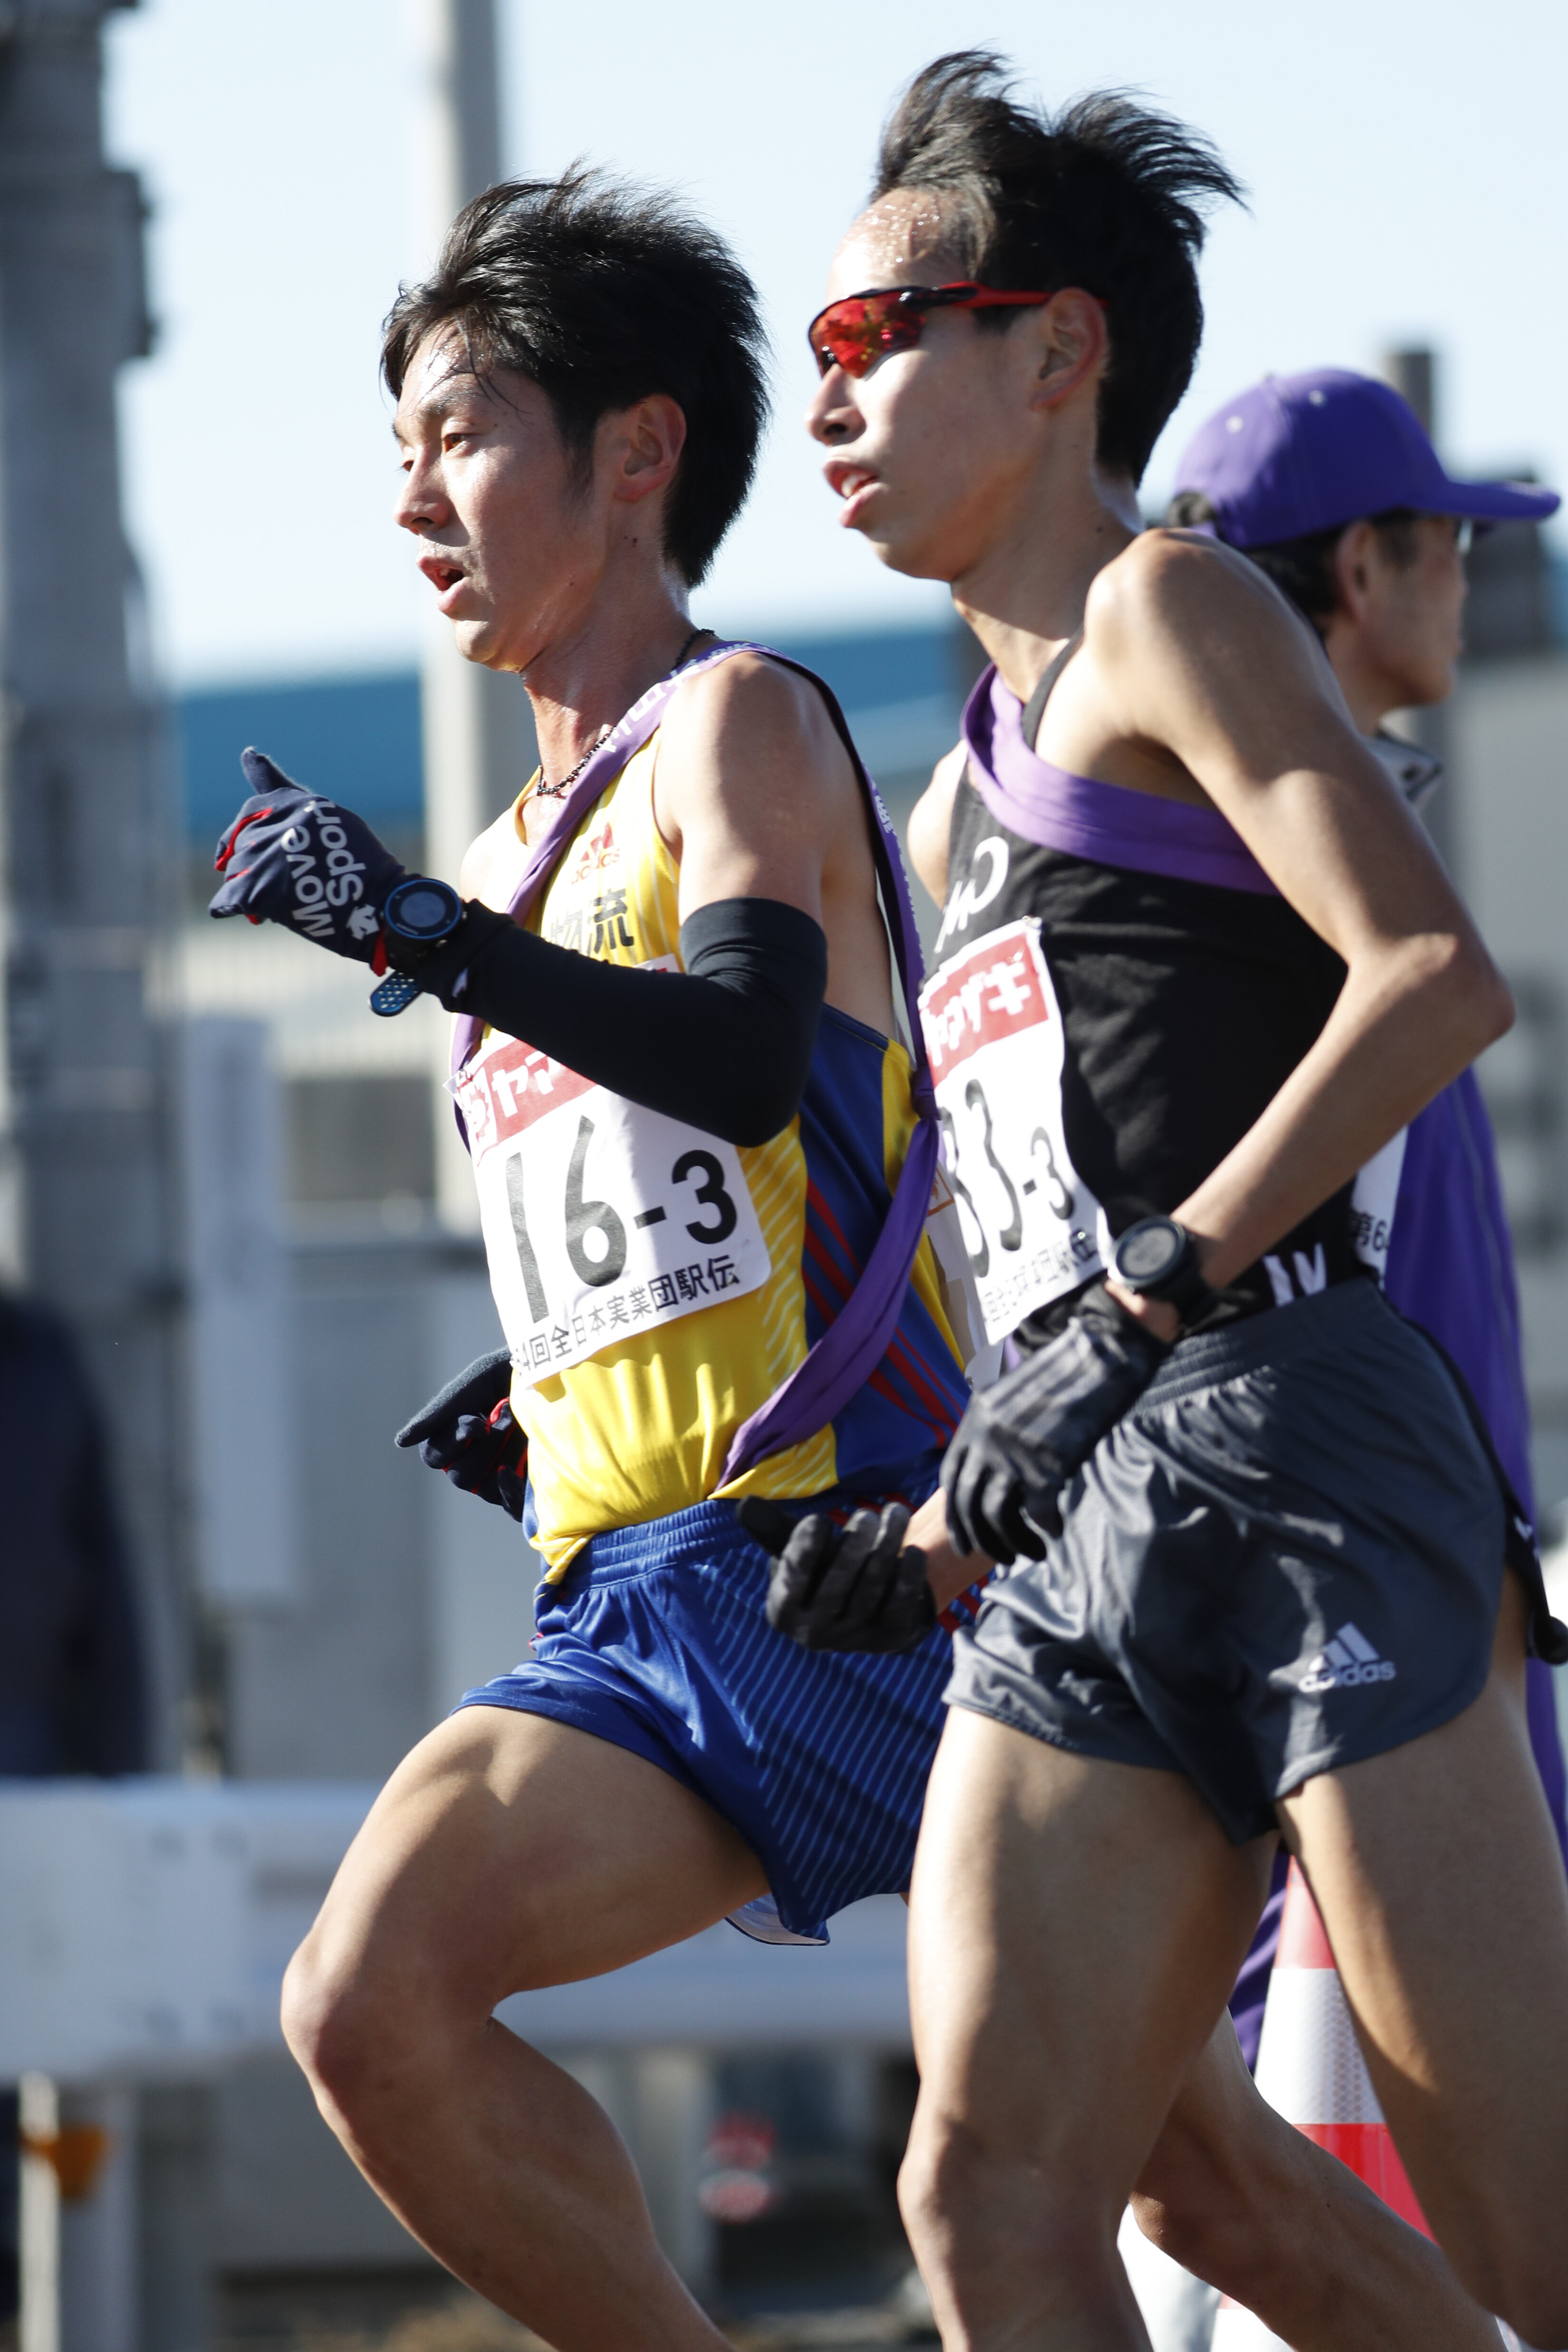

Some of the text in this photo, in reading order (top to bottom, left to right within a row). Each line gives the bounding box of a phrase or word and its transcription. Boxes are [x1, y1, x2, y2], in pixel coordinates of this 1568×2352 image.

[281, 825, 336, 937] Move
[303, 800, 367, 907] Sport
[506, 1114, 738, 1324] 16-3
[1298, 1660, 1396, 1693] adidas
